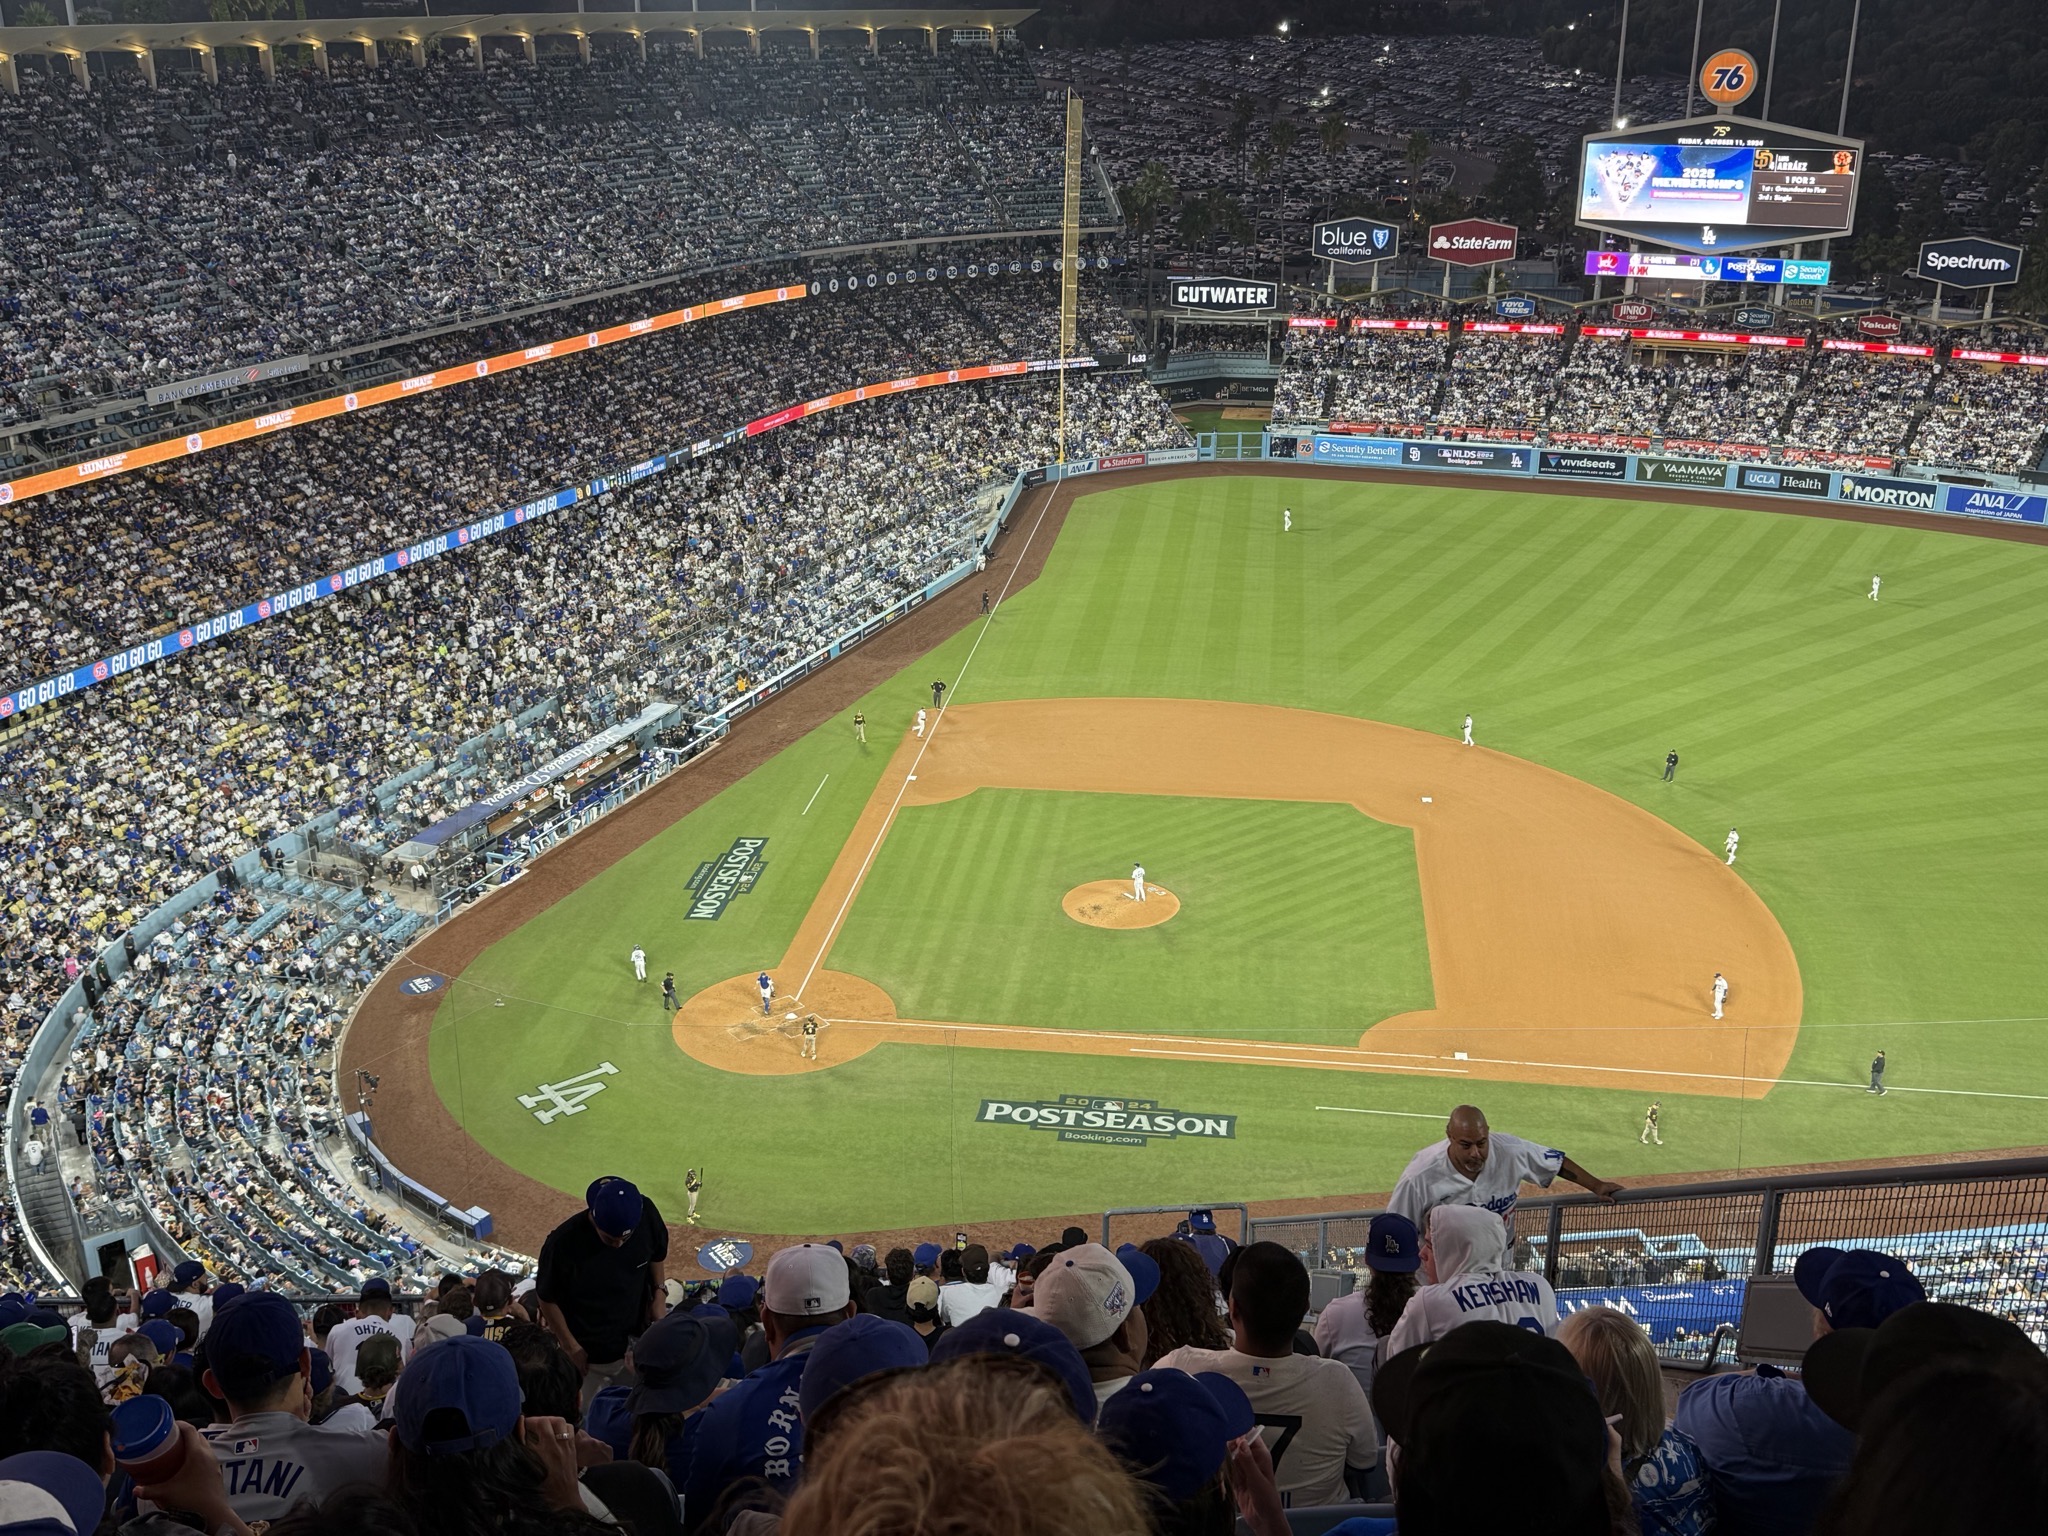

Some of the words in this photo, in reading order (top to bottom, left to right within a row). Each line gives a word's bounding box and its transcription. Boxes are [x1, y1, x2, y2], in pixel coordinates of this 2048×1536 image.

[1712, 66, 1746, 91] 76
[1682, 168, 1715, 178] 2025
[1652, 177, 1745, 190] MEMBERSHIPS
[1321, 227, 1367, 246] blue
[1702, 226, 1716, 244] LA
[1328, 245, 1372, 256] california
[1727, 263, 1775, 272] POSTSEASON
[1927, 252, 2006, 271] Spectrum
[1800, 266, 1826, 276] Security
[1178, 286, 1268, 304] CUTWATER
[1788, 299, 1813, 307] GOLDEN
[1619, 305, 1647, 315] JINRO
[1749, 311, 1771, 319] Security
[1862, 321, 1898, 330] Yakult
[1132, 354, 1147, 363] 6:33
[158, 390, 184, 402] BANK
[186, 386, 199, 396] OF
[200, 375, 241, 392] AMERICA
[1171, 387, 1193, 395] BETMGM
[1300, 443, 1312, 452] 76
[1331, 443, 1365, 455] Security
[1367, 446, 1396, 455] Benefit
[1453, 450, 1476, 459] NLDS
[1447, 458, 1483, 466] Booking.com
[1511, 453, 1522, 467] LA
[1561, 458, 1616, 469] vividseats
[1070, 464, 1087, 475] ANA
[1749, 474, 1775, 484] UCLA
[1783, 476, 1821, 490] Health
[1854, 486, 1934, 509] MORTON
[1966, 493, 2005, 508] ANA
[526, 503, 535, 519] GO
[537, 499, 546, 515] GO
[1965, 507, 1994, 516] Inspiration
[471, 523, 481, 540] GO
[483, 519, 492, 535] GO
[410, 545, 422, 562] GO
[424, 540, 434, 557] GO
[345, 568, 357, 586] GO
[360, 563, 371, 581] GO
[274, 594, 287, 613] GO
[290, 588, 302, 607] GO
[197, 622, 210, 642] GO
[213, 616, 226, 636] GO
[112, 653, 127, 674] GO
[130, 646, 144, 667] GO
[19, 688, 35, 710] GO
[39, 680, 54, 702] GO
[729, 702, 750, 718] Booking.com
[593, 731, 621, 746] Los
[542, 743, 593, 772] Angeles
[481, 771, 550, 806] Dodgers
[690, 863, 713, 888] Booking.com
[751, 863, 763, 872] 20
[690, 839, 764, 918] POSTSEASON
[739, 883, 750, 892] 24
[516, 1061, 621, 1125] LA
[1065, 1097, 1089, 1106] 20
[1128, 1102, 1151, 1110] 24
[984, 1102, 1228, 1136] POSTSEASON
[1065, 1132, 1142, 1144] Booking.com
[1386, 1234, 1399, 1254] LA
[711, 1243, 739, 1266] NLDS
[1452, 1279, 1540, 1312] KERSHAW
[764, 1386, 800, 1478] BORN
